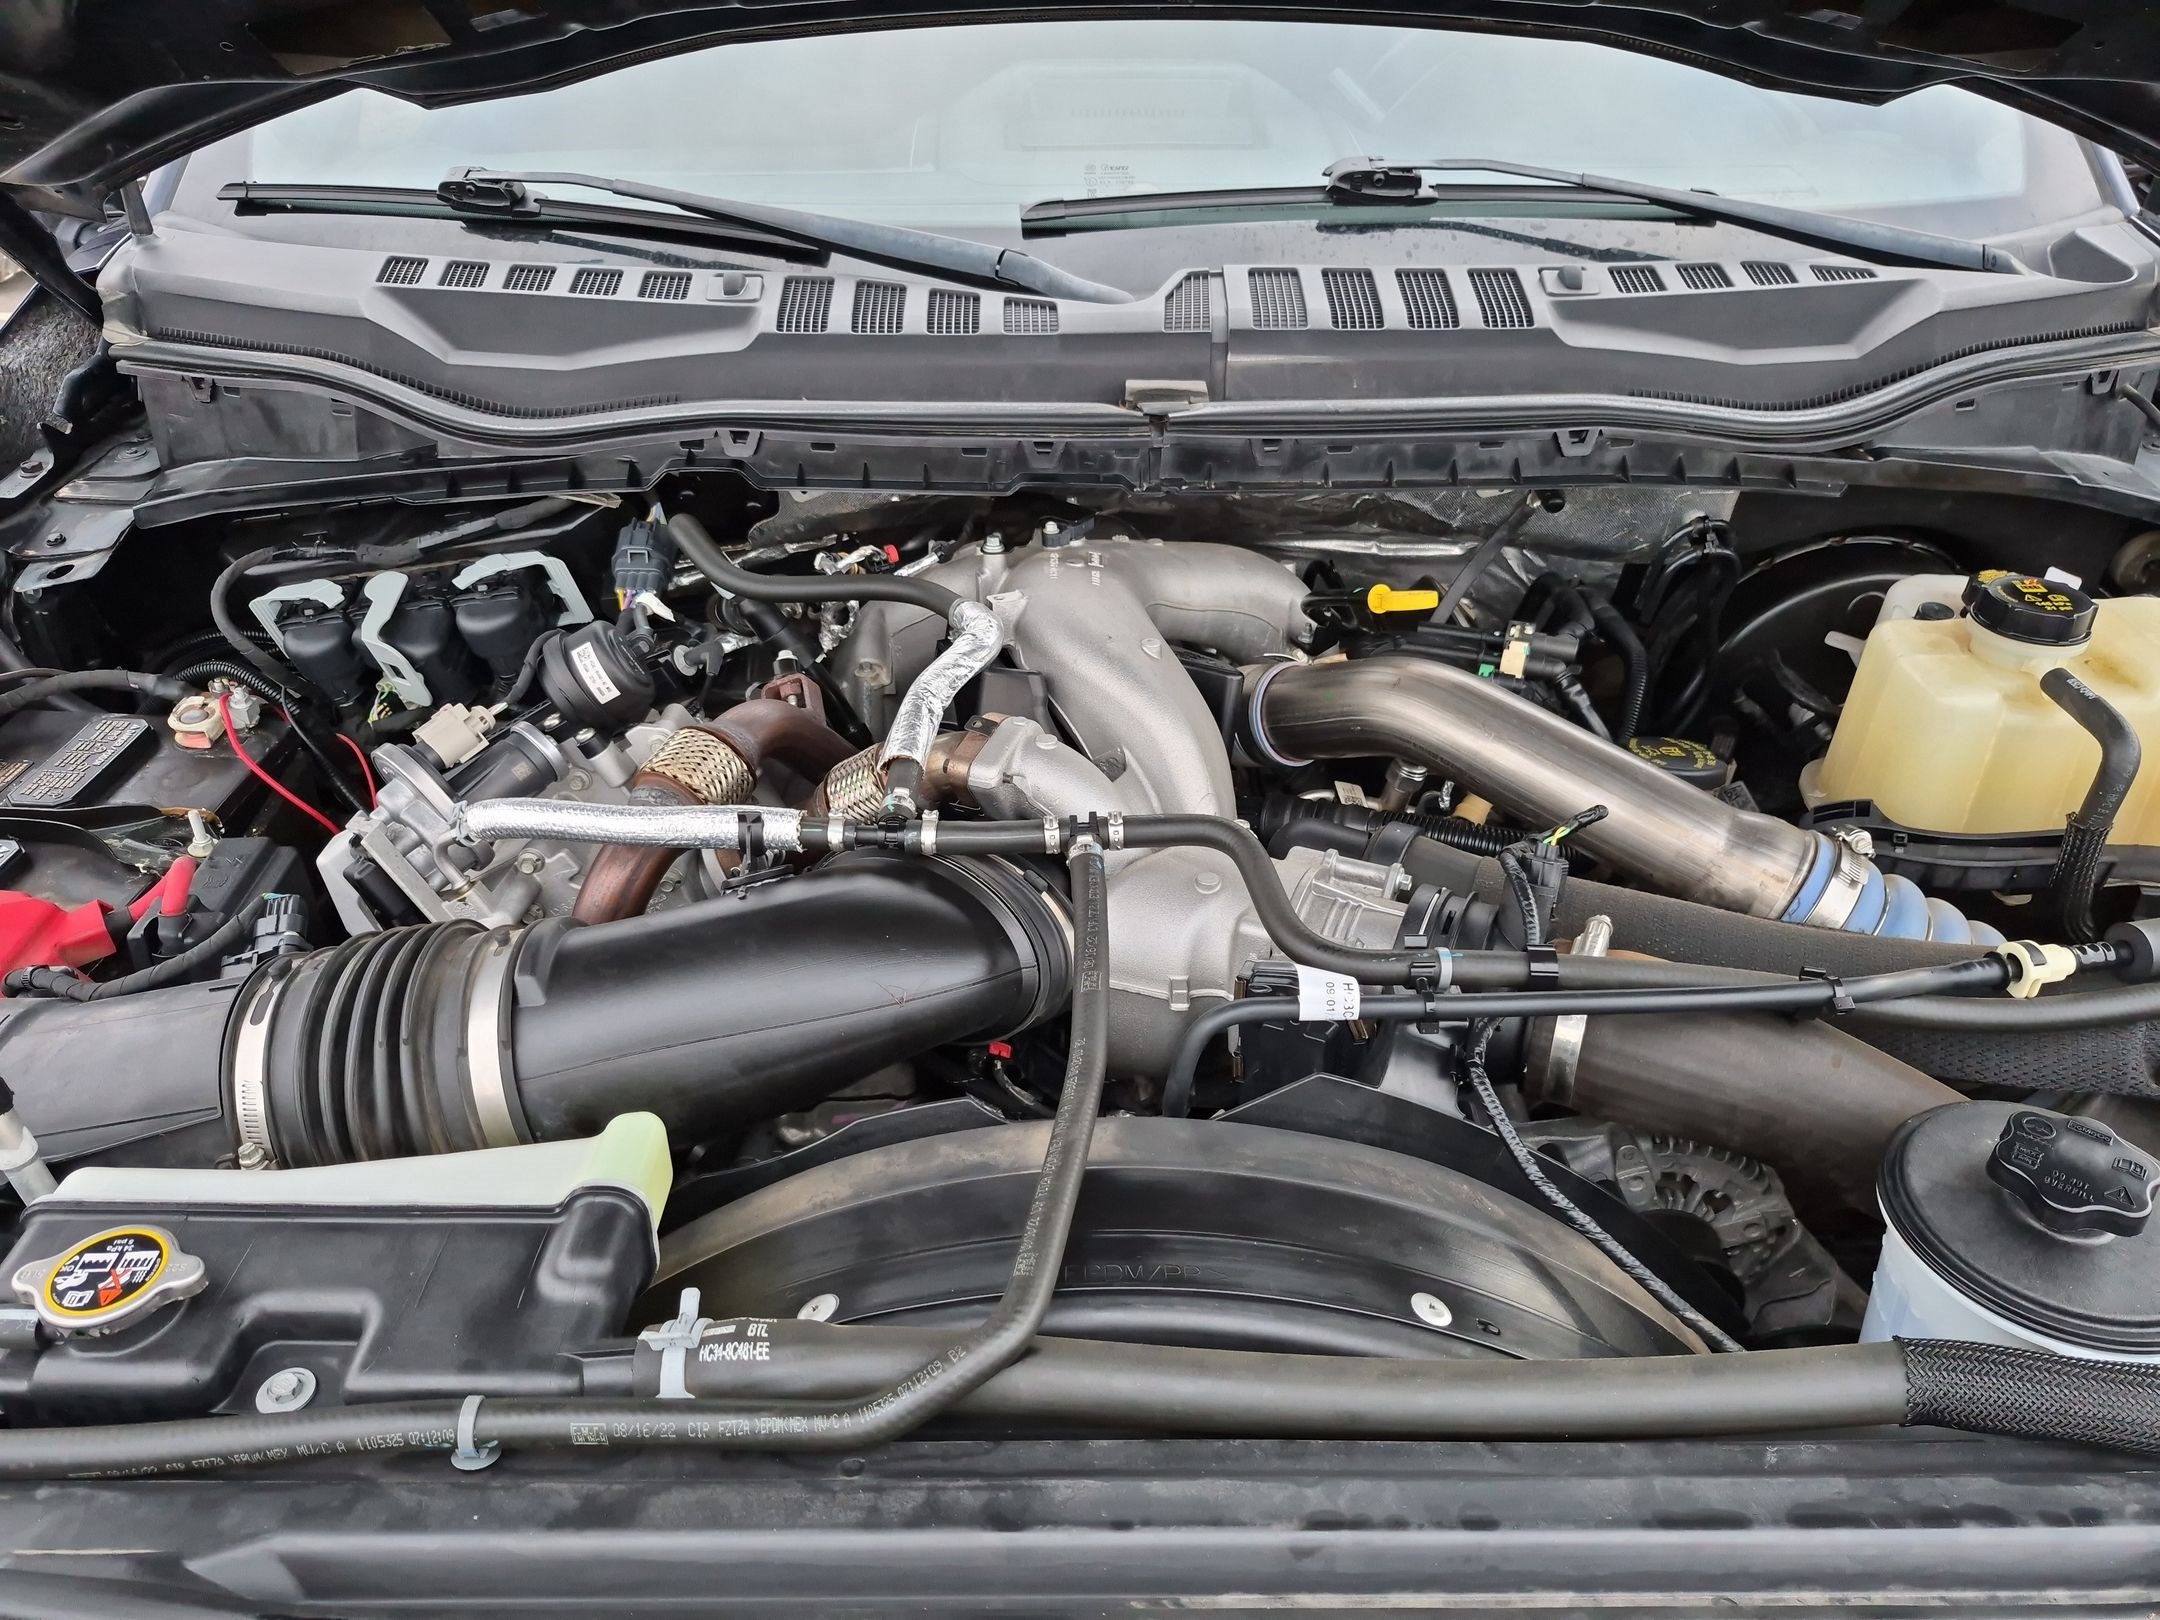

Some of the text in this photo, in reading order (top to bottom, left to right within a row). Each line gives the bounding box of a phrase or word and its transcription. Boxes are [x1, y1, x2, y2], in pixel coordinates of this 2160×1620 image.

[612, 1421, 677, 1439] 08/16/22
[843, 1412, 852, 1429] A
[858, 1392, 897, 1424] 1105325
[356, 1432, 404, 1451] 1105325
[408, 1428, 455, 1445] 07:12:09
